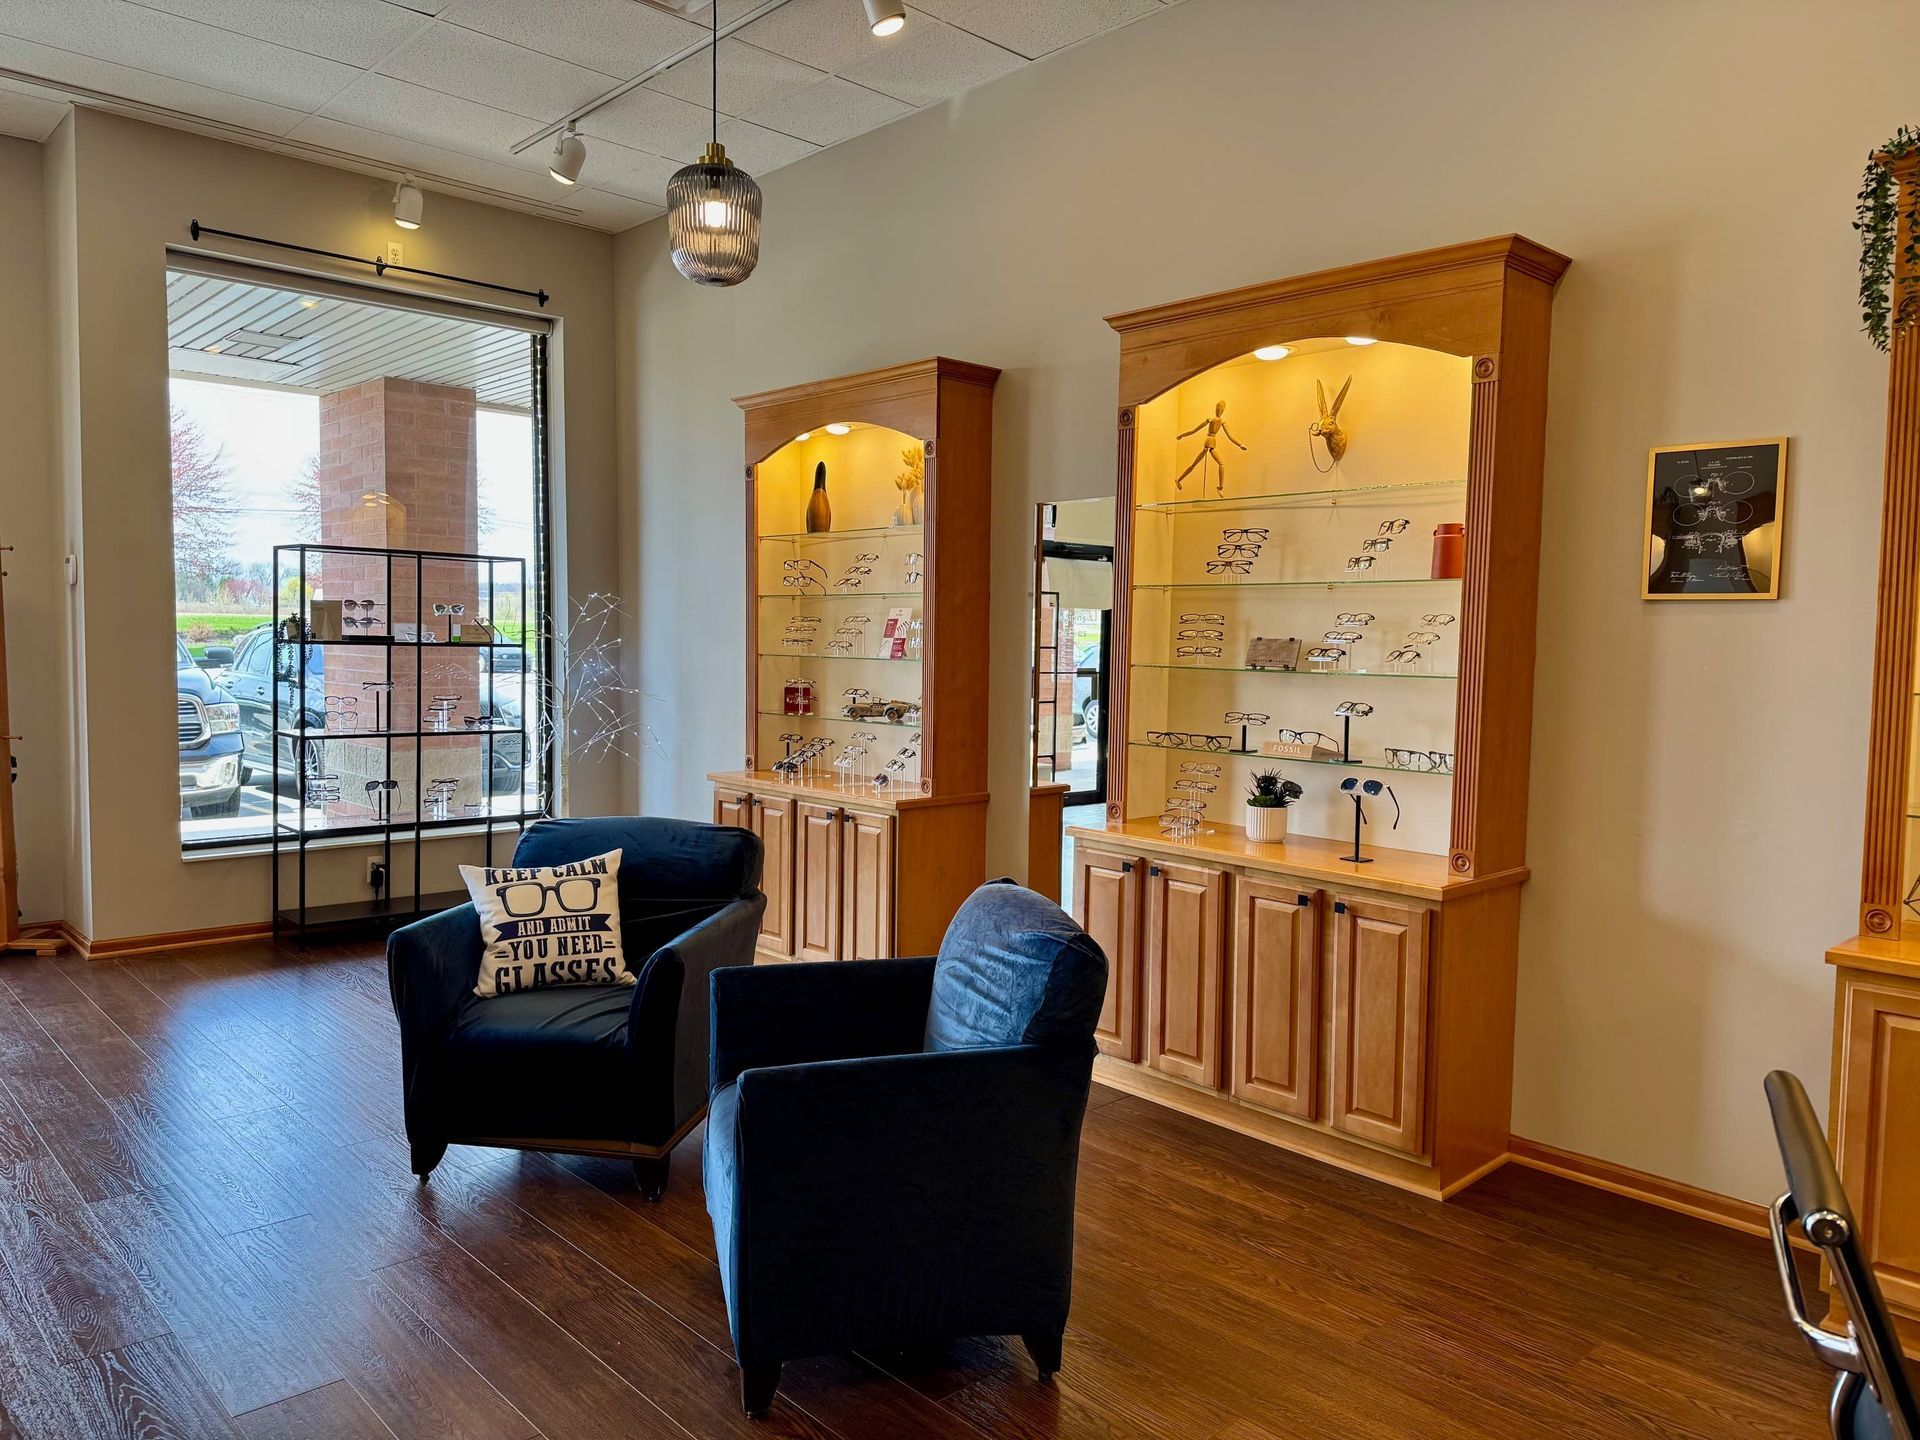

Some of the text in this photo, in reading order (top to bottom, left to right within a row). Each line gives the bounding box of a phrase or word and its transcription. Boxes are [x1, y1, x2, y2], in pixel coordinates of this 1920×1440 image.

[1273, 744, 1301, 754] FOSSIL
[485, 857, 608, 886] KEEP CALM
[517, 916, 591, 936] AND ADMIT
[508, 934, 603, 961] YOU NEED
[495, 957, 616, 993] GLASSES
